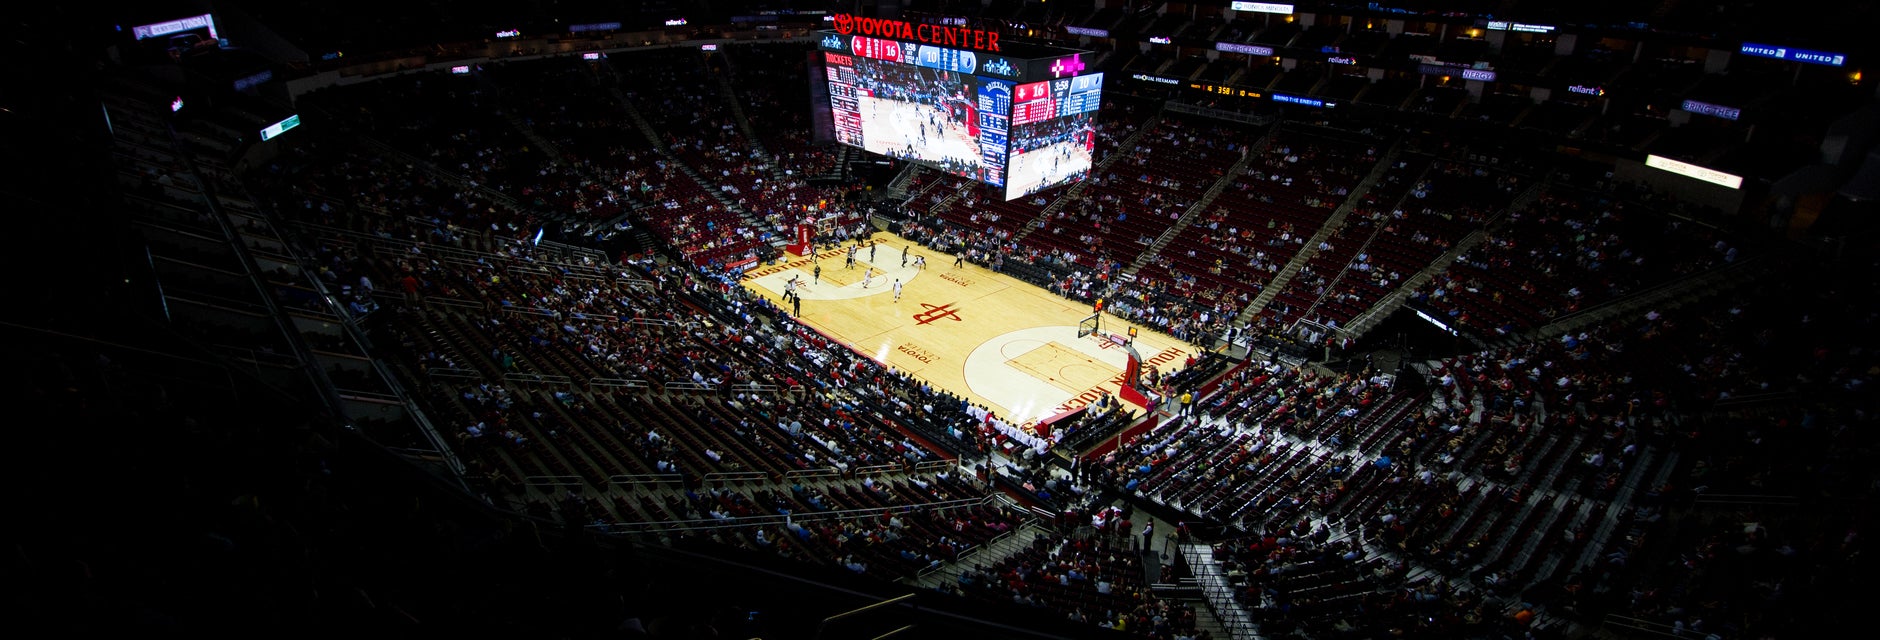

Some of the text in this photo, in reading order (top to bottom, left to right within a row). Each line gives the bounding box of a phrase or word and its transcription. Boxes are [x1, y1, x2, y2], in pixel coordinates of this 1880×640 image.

[854, 16, 1001, 52] TOYOTA CENTER
[886, 45, 896, 57] 16
[926, 51, 937, 63] 10
[1742, 46, 1775, 55] UNITED
[1795, 53, 1831, 62] UNITED
[825, 52, 853, 66] ROCKETS
[1328, 57, 1349, 65] reliant
[1033, 77, 1090, 97] 16 3:58 10
[1568, 85, 1595, 95] reliant
[898, 345, 932, 364] TOYOTA
